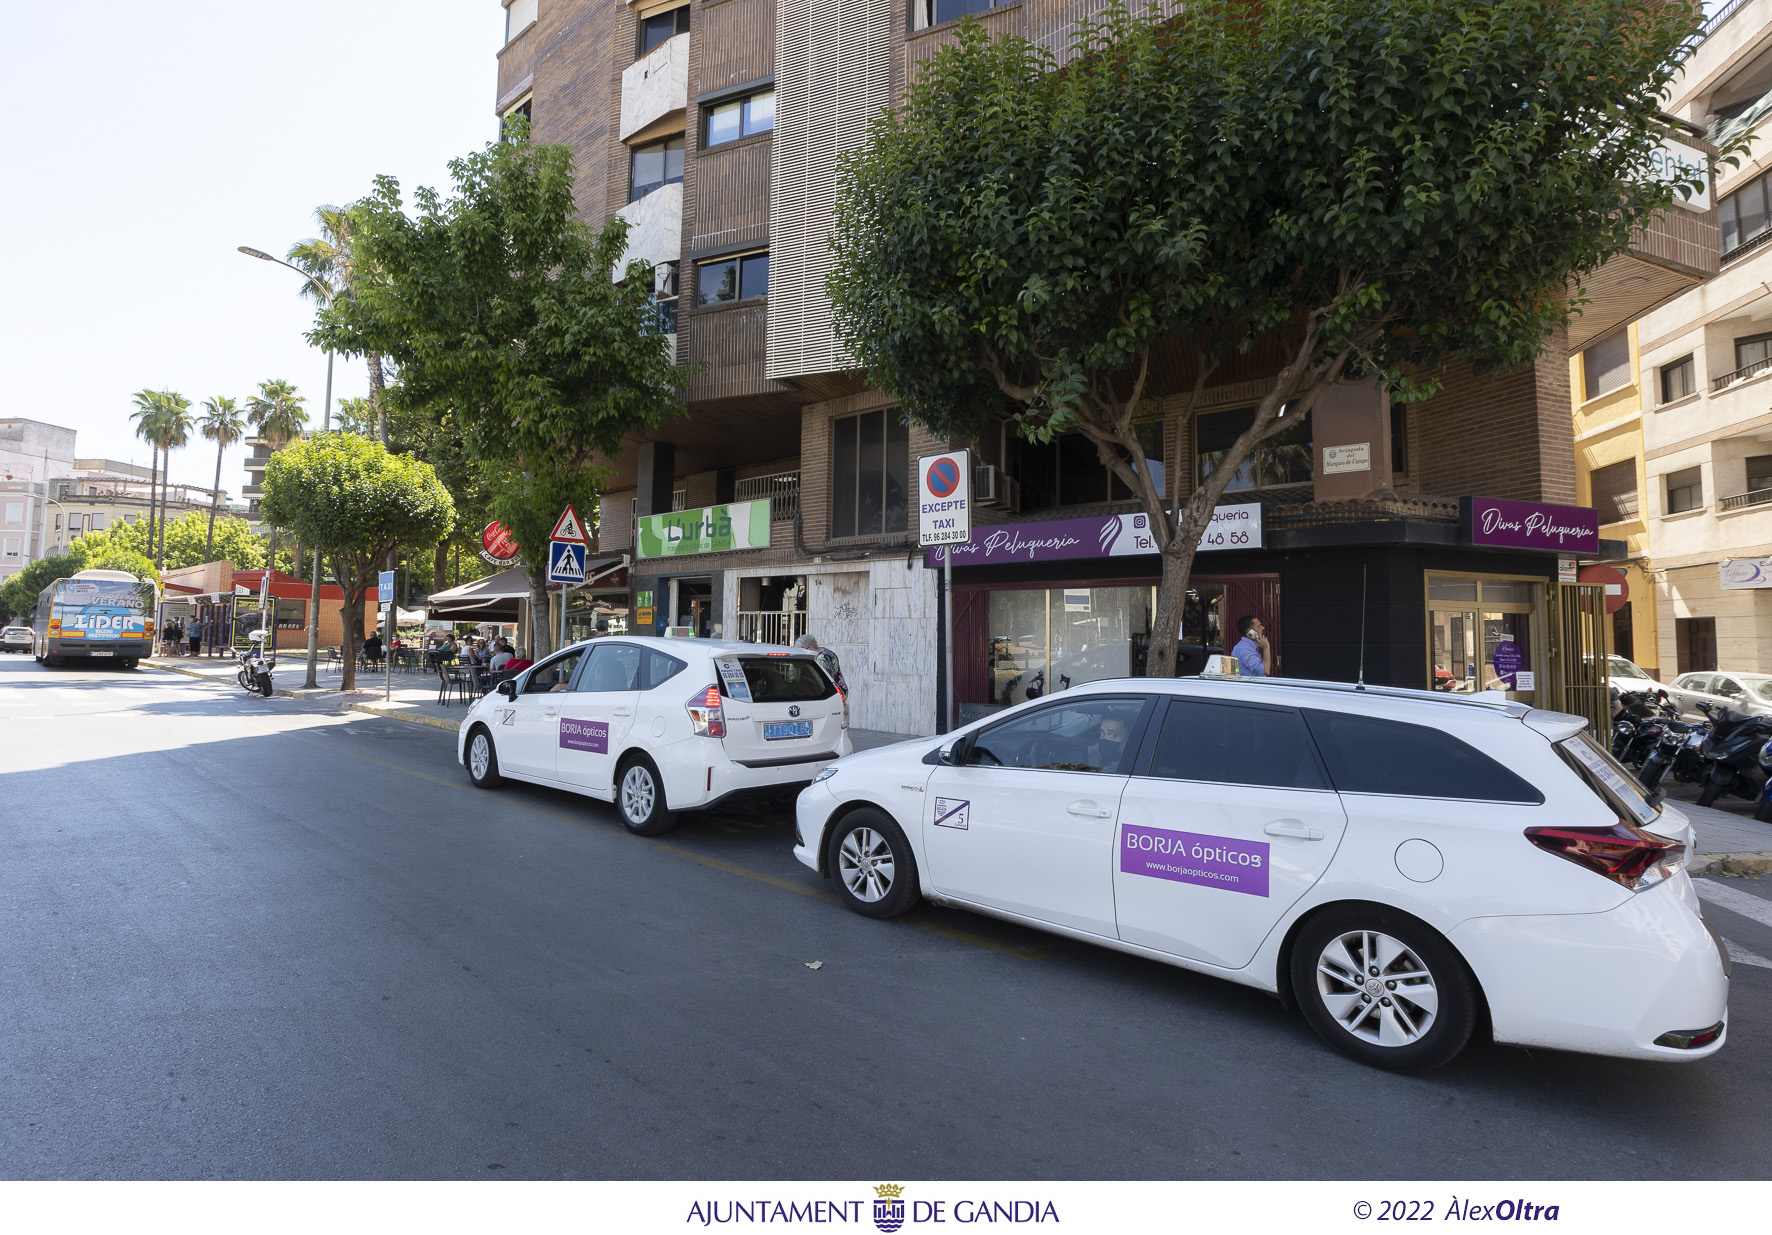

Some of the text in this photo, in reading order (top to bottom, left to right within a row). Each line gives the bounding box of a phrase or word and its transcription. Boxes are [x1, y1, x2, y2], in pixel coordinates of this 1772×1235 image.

[1650, 151, 1702, 181] ental
[922, 500, 966, 514] EXCEPTE
[933, 518, 954, 529] TAXI
[1481, 508, 1522, 534] Divas
[922, 534, 932, 542] TLF.
[941, 532, 950, 540] 284
[952, 530, 958, 539] 30
[960, 530, 966, 538] 00
[1134, 535, 1154, 549] Tel.
[1207, 533, 1224, 545] 48
[1230, 531, 1249, 544] 58
[380, 582, 392, 591] TAXI
[91, 596, 144, 608] VERANO
[561, 723, 606, 738] BORJA ópticos
[568, 739, 599, 748] www.borjaopticos.com
[958, 814, 964, 824] 5
[1127, 833, 1262, 868] BORJA ópticos
[1146, 861, 1239, 883] www.borjaopticos.com
